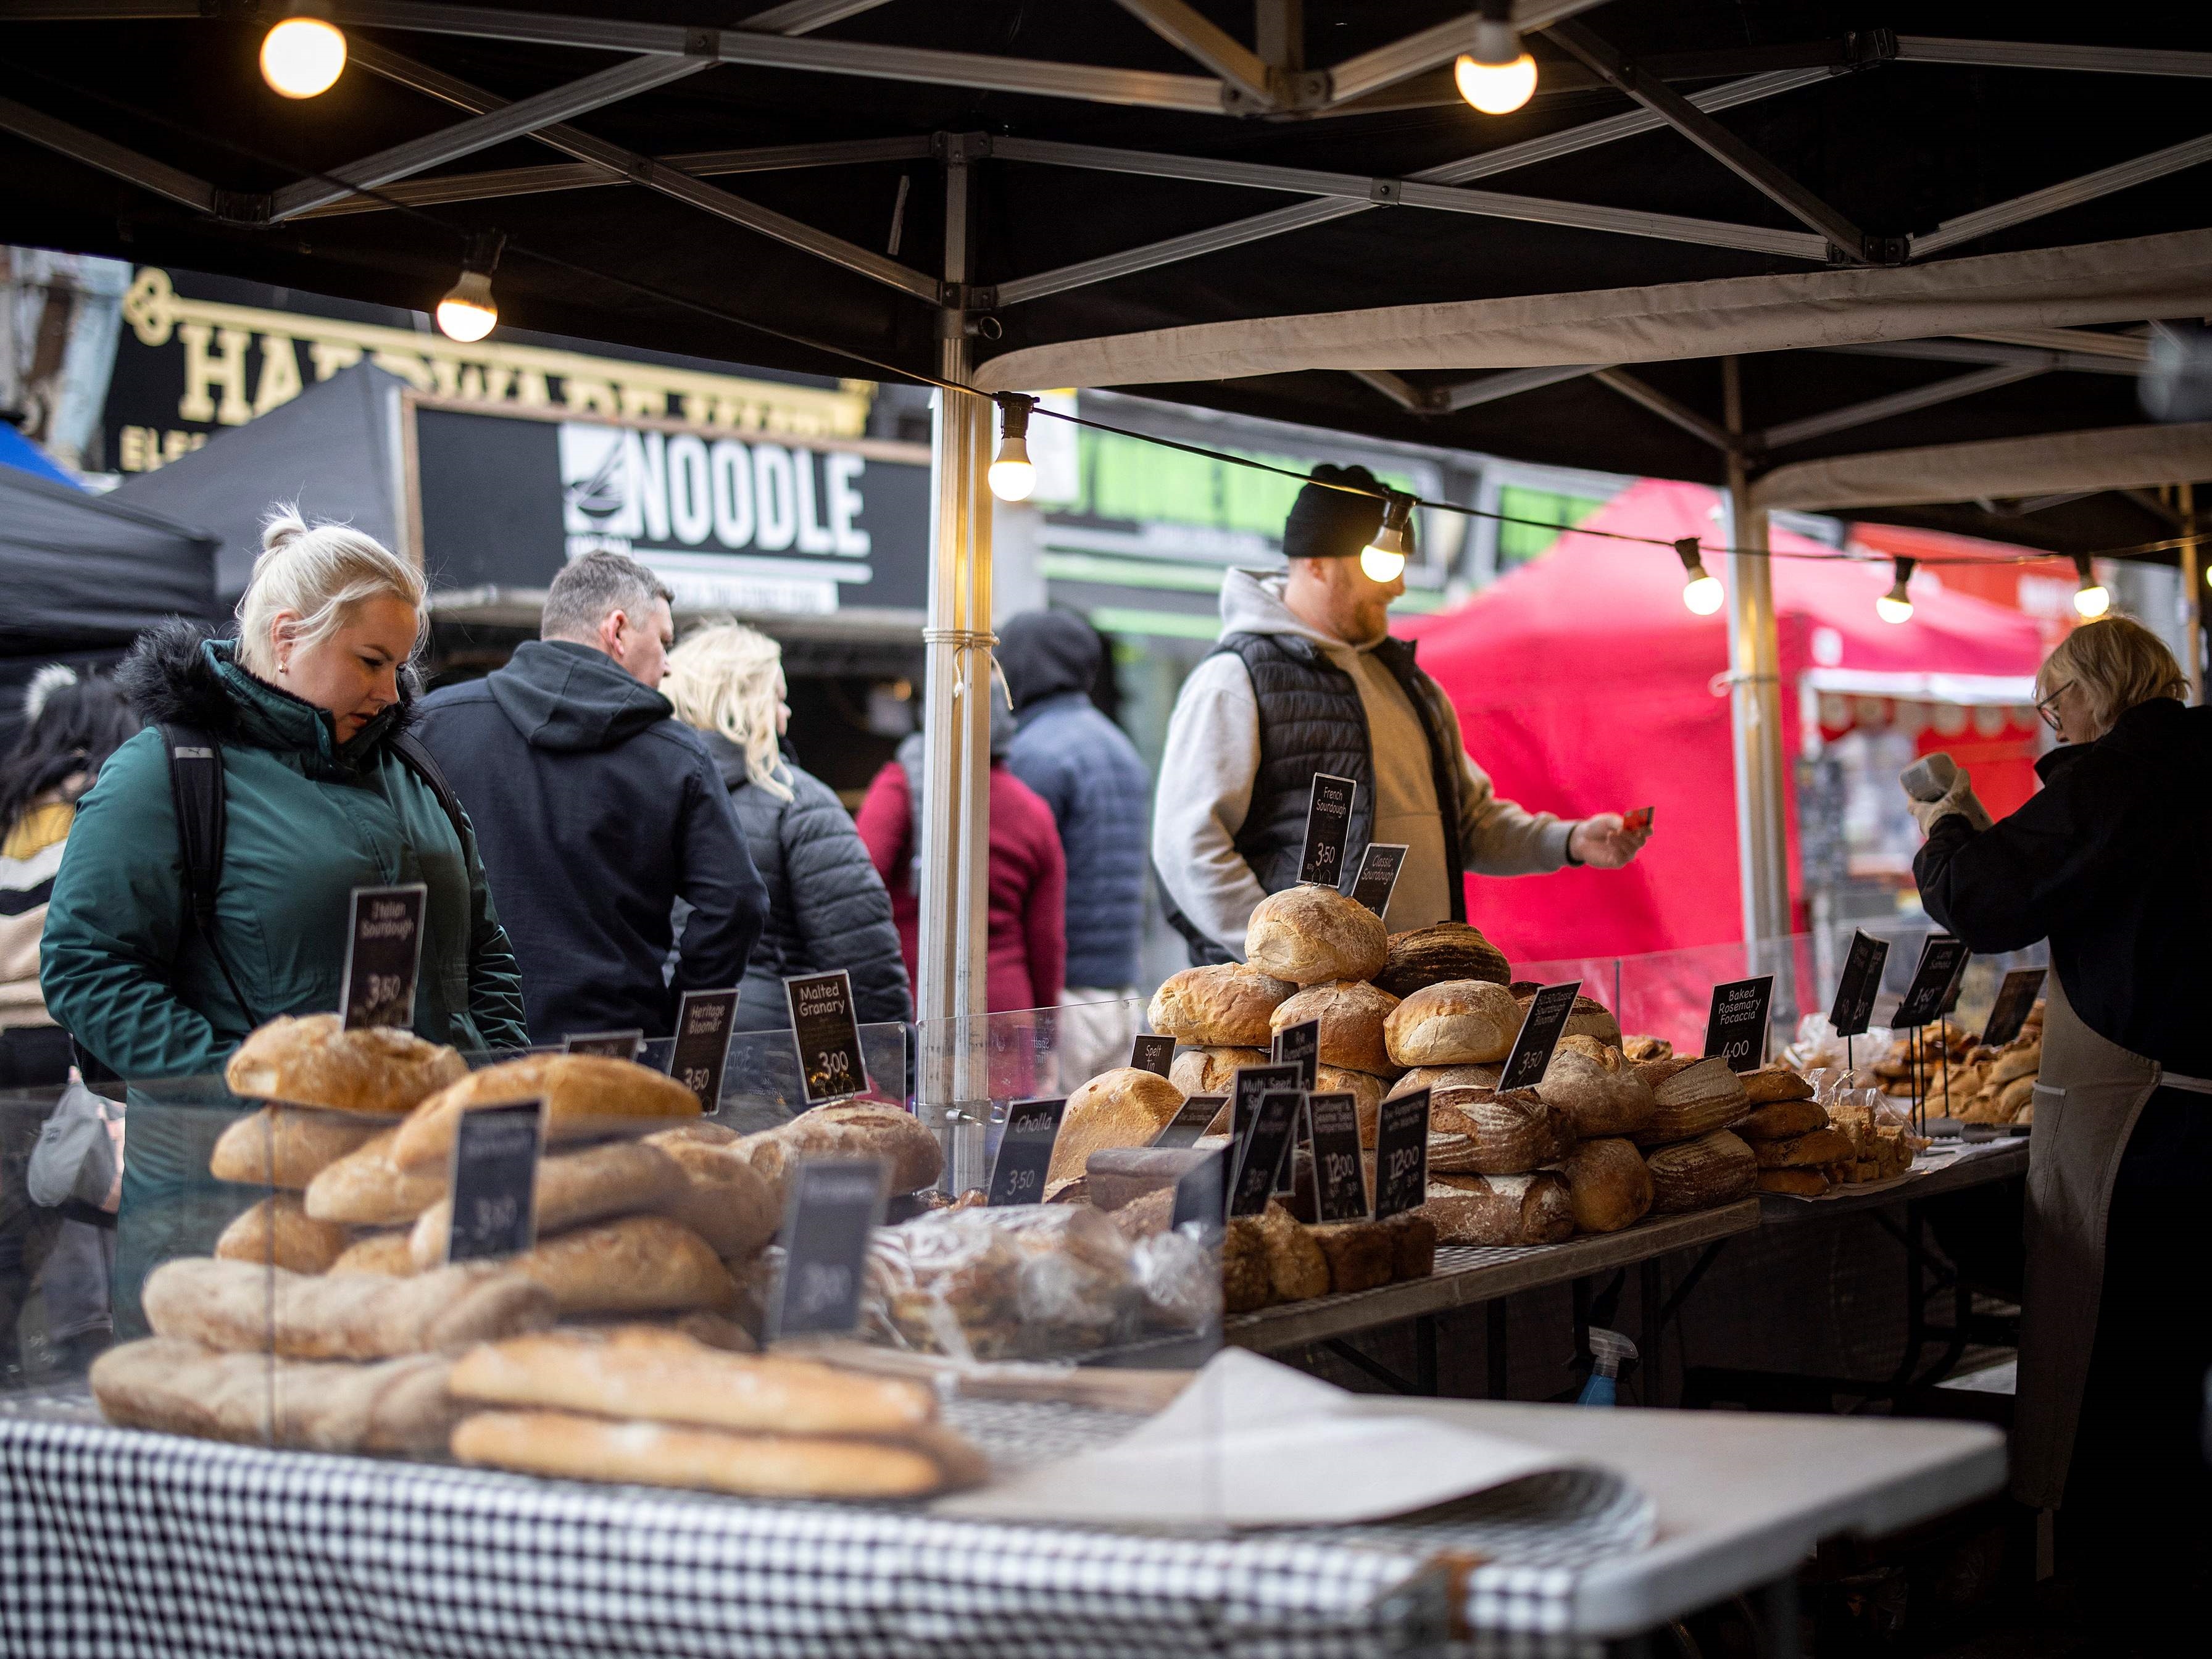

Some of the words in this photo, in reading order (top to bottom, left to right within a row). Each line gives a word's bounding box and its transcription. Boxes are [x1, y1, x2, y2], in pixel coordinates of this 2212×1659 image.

[625, 428, 871, 558] NOODLE
[1323, 786, 1343, 801] French
[1316, 799, 1346, 818] Sourdough
[1372, 854, 1394, 867] Classic
[1362, 868, 1394, 885] Sourdough
[359, 918, 415, 941] Sourdough
[800, 983, 840, 1001] Malted
[1729, 986, 1755, 1002] Baked
[691, 1003, 726, 1020] Heritage
[799, 999, 846, 1017] Granary
[1718, 998, 1761, 1015] Rosemary
[1720, 1009, 1756, 1025] Focaccia
[690, 1019, 722, 1034] Bloomer
[1145, 1044, 1162, 1058] Spelt
[1146, 1059, 1155, 1071] Tin
[1017, 1112, 1052, 1133] Cholla
